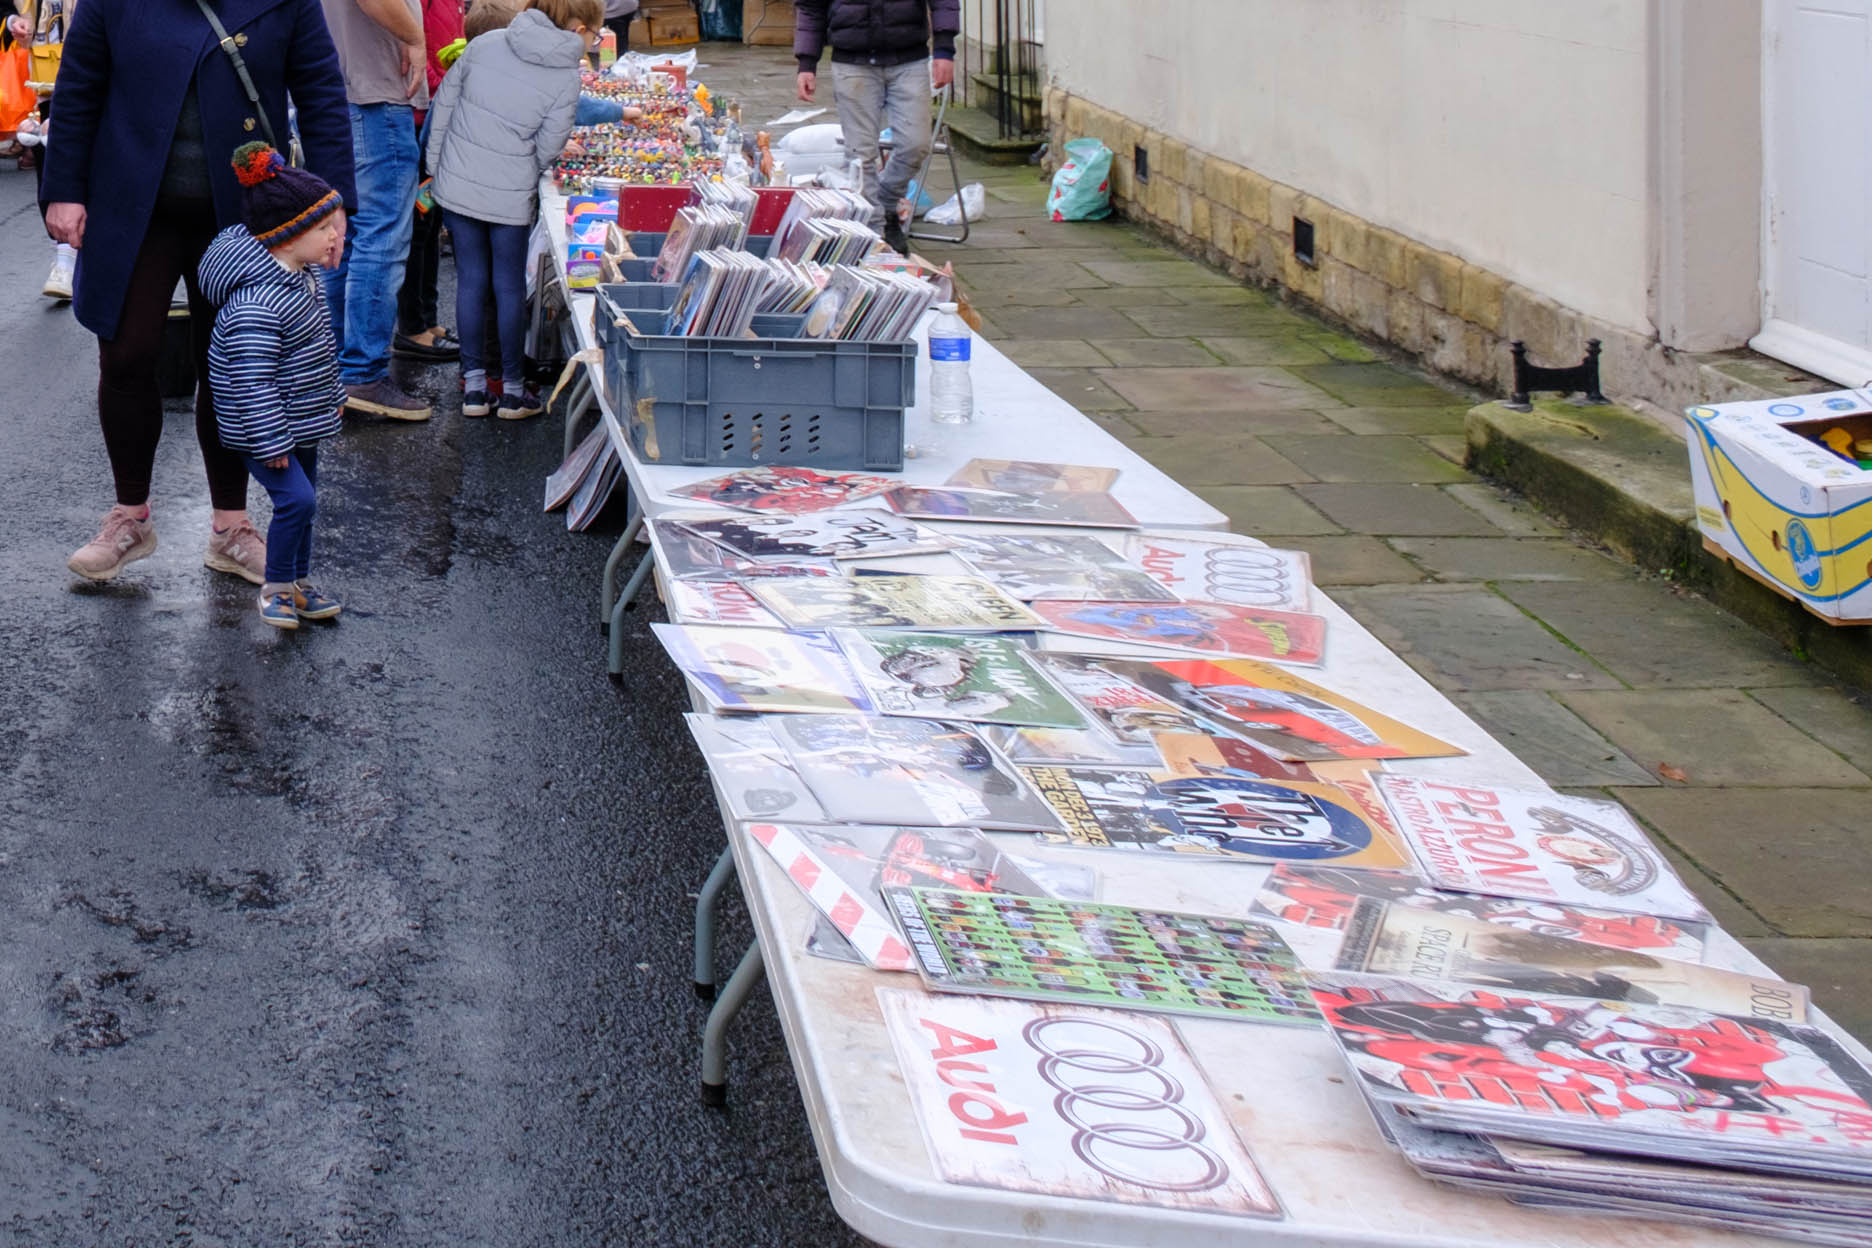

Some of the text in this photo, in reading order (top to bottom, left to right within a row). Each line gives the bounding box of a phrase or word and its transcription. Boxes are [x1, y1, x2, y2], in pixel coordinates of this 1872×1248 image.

[1030, 767, 1060, 790] THE
[1050, 767, 1110, 847] MON DEC 3 1973
[1384, 776, 1435, 824] NASTRO
[1238, 792, 1330, 838] The
[1423, 781, 1559, 897] PERONI
[920, 1017, 1029, 1147] Audi
